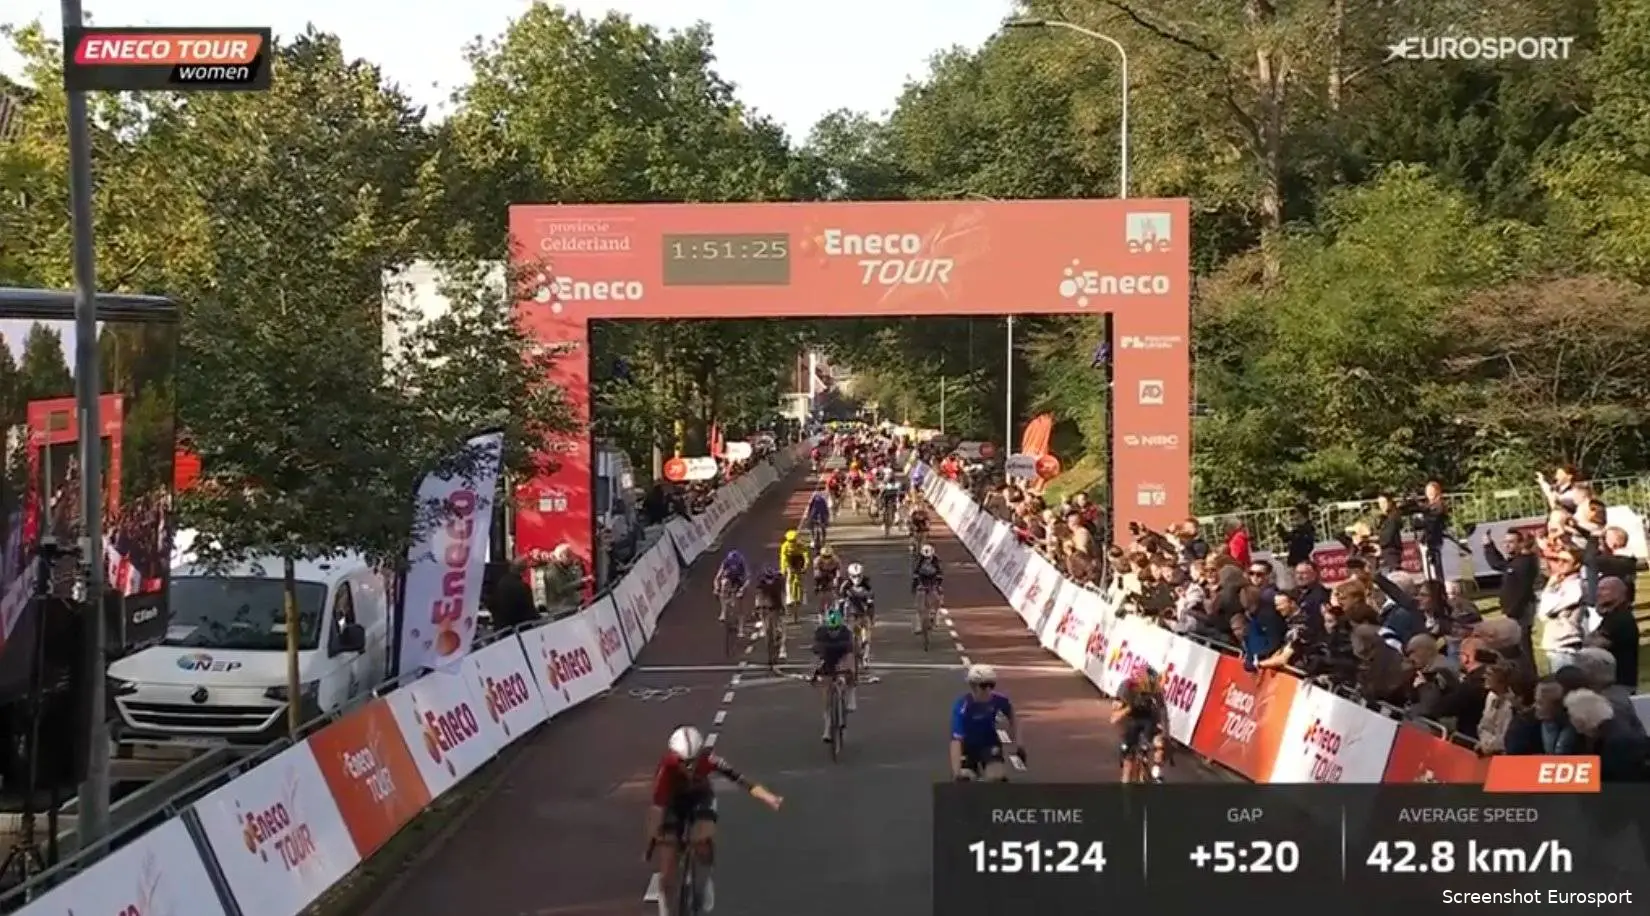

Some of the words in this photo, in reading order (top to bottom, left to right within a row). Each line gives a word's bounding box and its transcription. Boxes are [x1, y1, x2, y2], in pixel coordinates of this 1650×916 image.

[549, 220, 609, 235] provincie
[824, 229, 921, 255] Eneco
[540, 235, 631, 251] Gelderland
[672, 240, 788, 260] 1:51:25
[858, 259, 955, 285] TOUR
[1081, 271, 1171, 295] Eneco
[554, 276, 644, 301] Eneco
[431, 489, 476, 625] Eneco
[194, 660, 242, 672] NEP
[550, 647, 593, 684] Eneco
[486, 672, 530, 716] Eneco
[425, 702, 480, 754] Eneco
[1221, 710, 1257, 743] TOUR
[366, 767, 397, 803] TOUR
[245, 801, 291, 844] Eneco
[274, 823, 317, 872] TOUR
